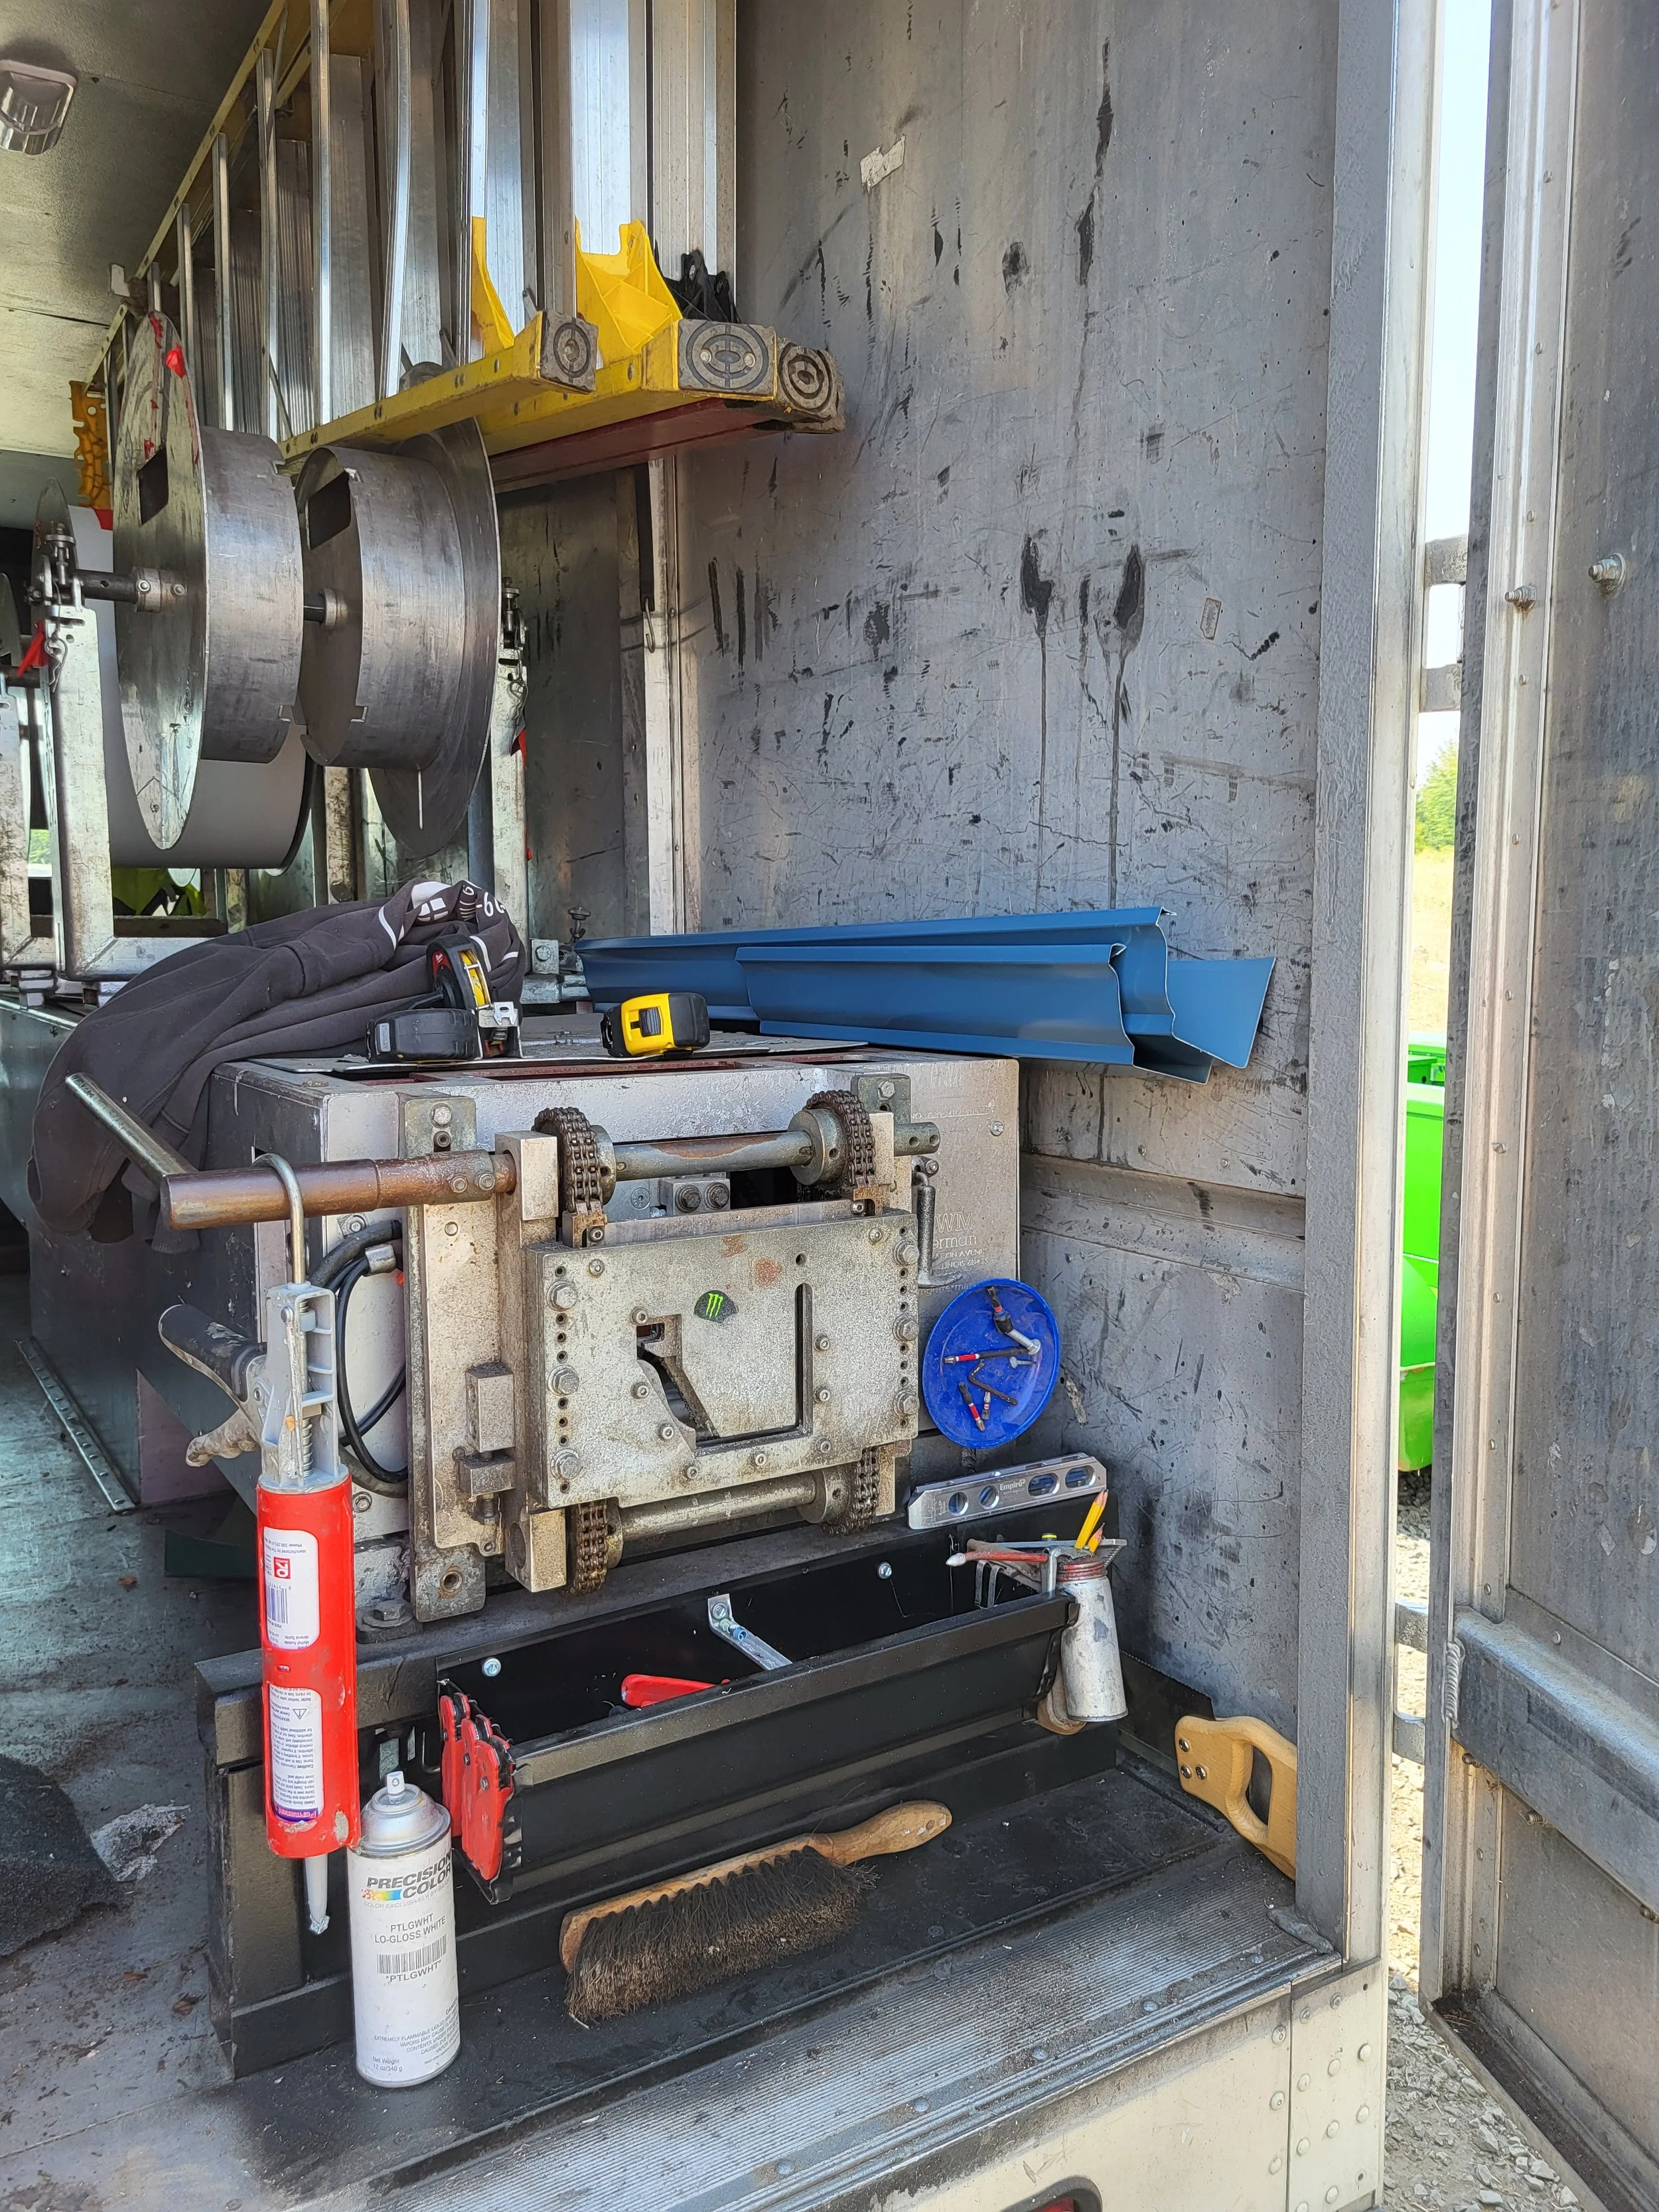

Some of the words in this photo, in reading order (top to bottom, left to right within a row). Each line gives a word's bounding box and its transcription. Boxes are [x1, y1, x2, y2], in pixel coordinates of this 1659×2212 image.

[934, 1211, 975, 1233] WM
[933, 1235, 977, 1250] erman
[999, 1478, 1026, 1492] Empire
[367, 1852, 451, 1889] PRECISION
[402, 1864, 451, 1899] COLOR
[386, 1895, 428, 1909] EXCLUSIVELY
[375, 1930, 421, 1944] LO-GLOSS
[423, 1915, 446, 1935] WHITE
[390, 1913, 434, 1933] PTLGWHT
[399, 2039, 420, 2047] VAPORS
[431, 2026, 445, 2037] CAUSE
[401, 2028, 431, 2041] FLAMMABLE
[431, 2020, 445, 2031] LIQUID
[406, 2040, 432, 2053] CONTENTS
[421, 2043, 439, 2055] CAUSES
